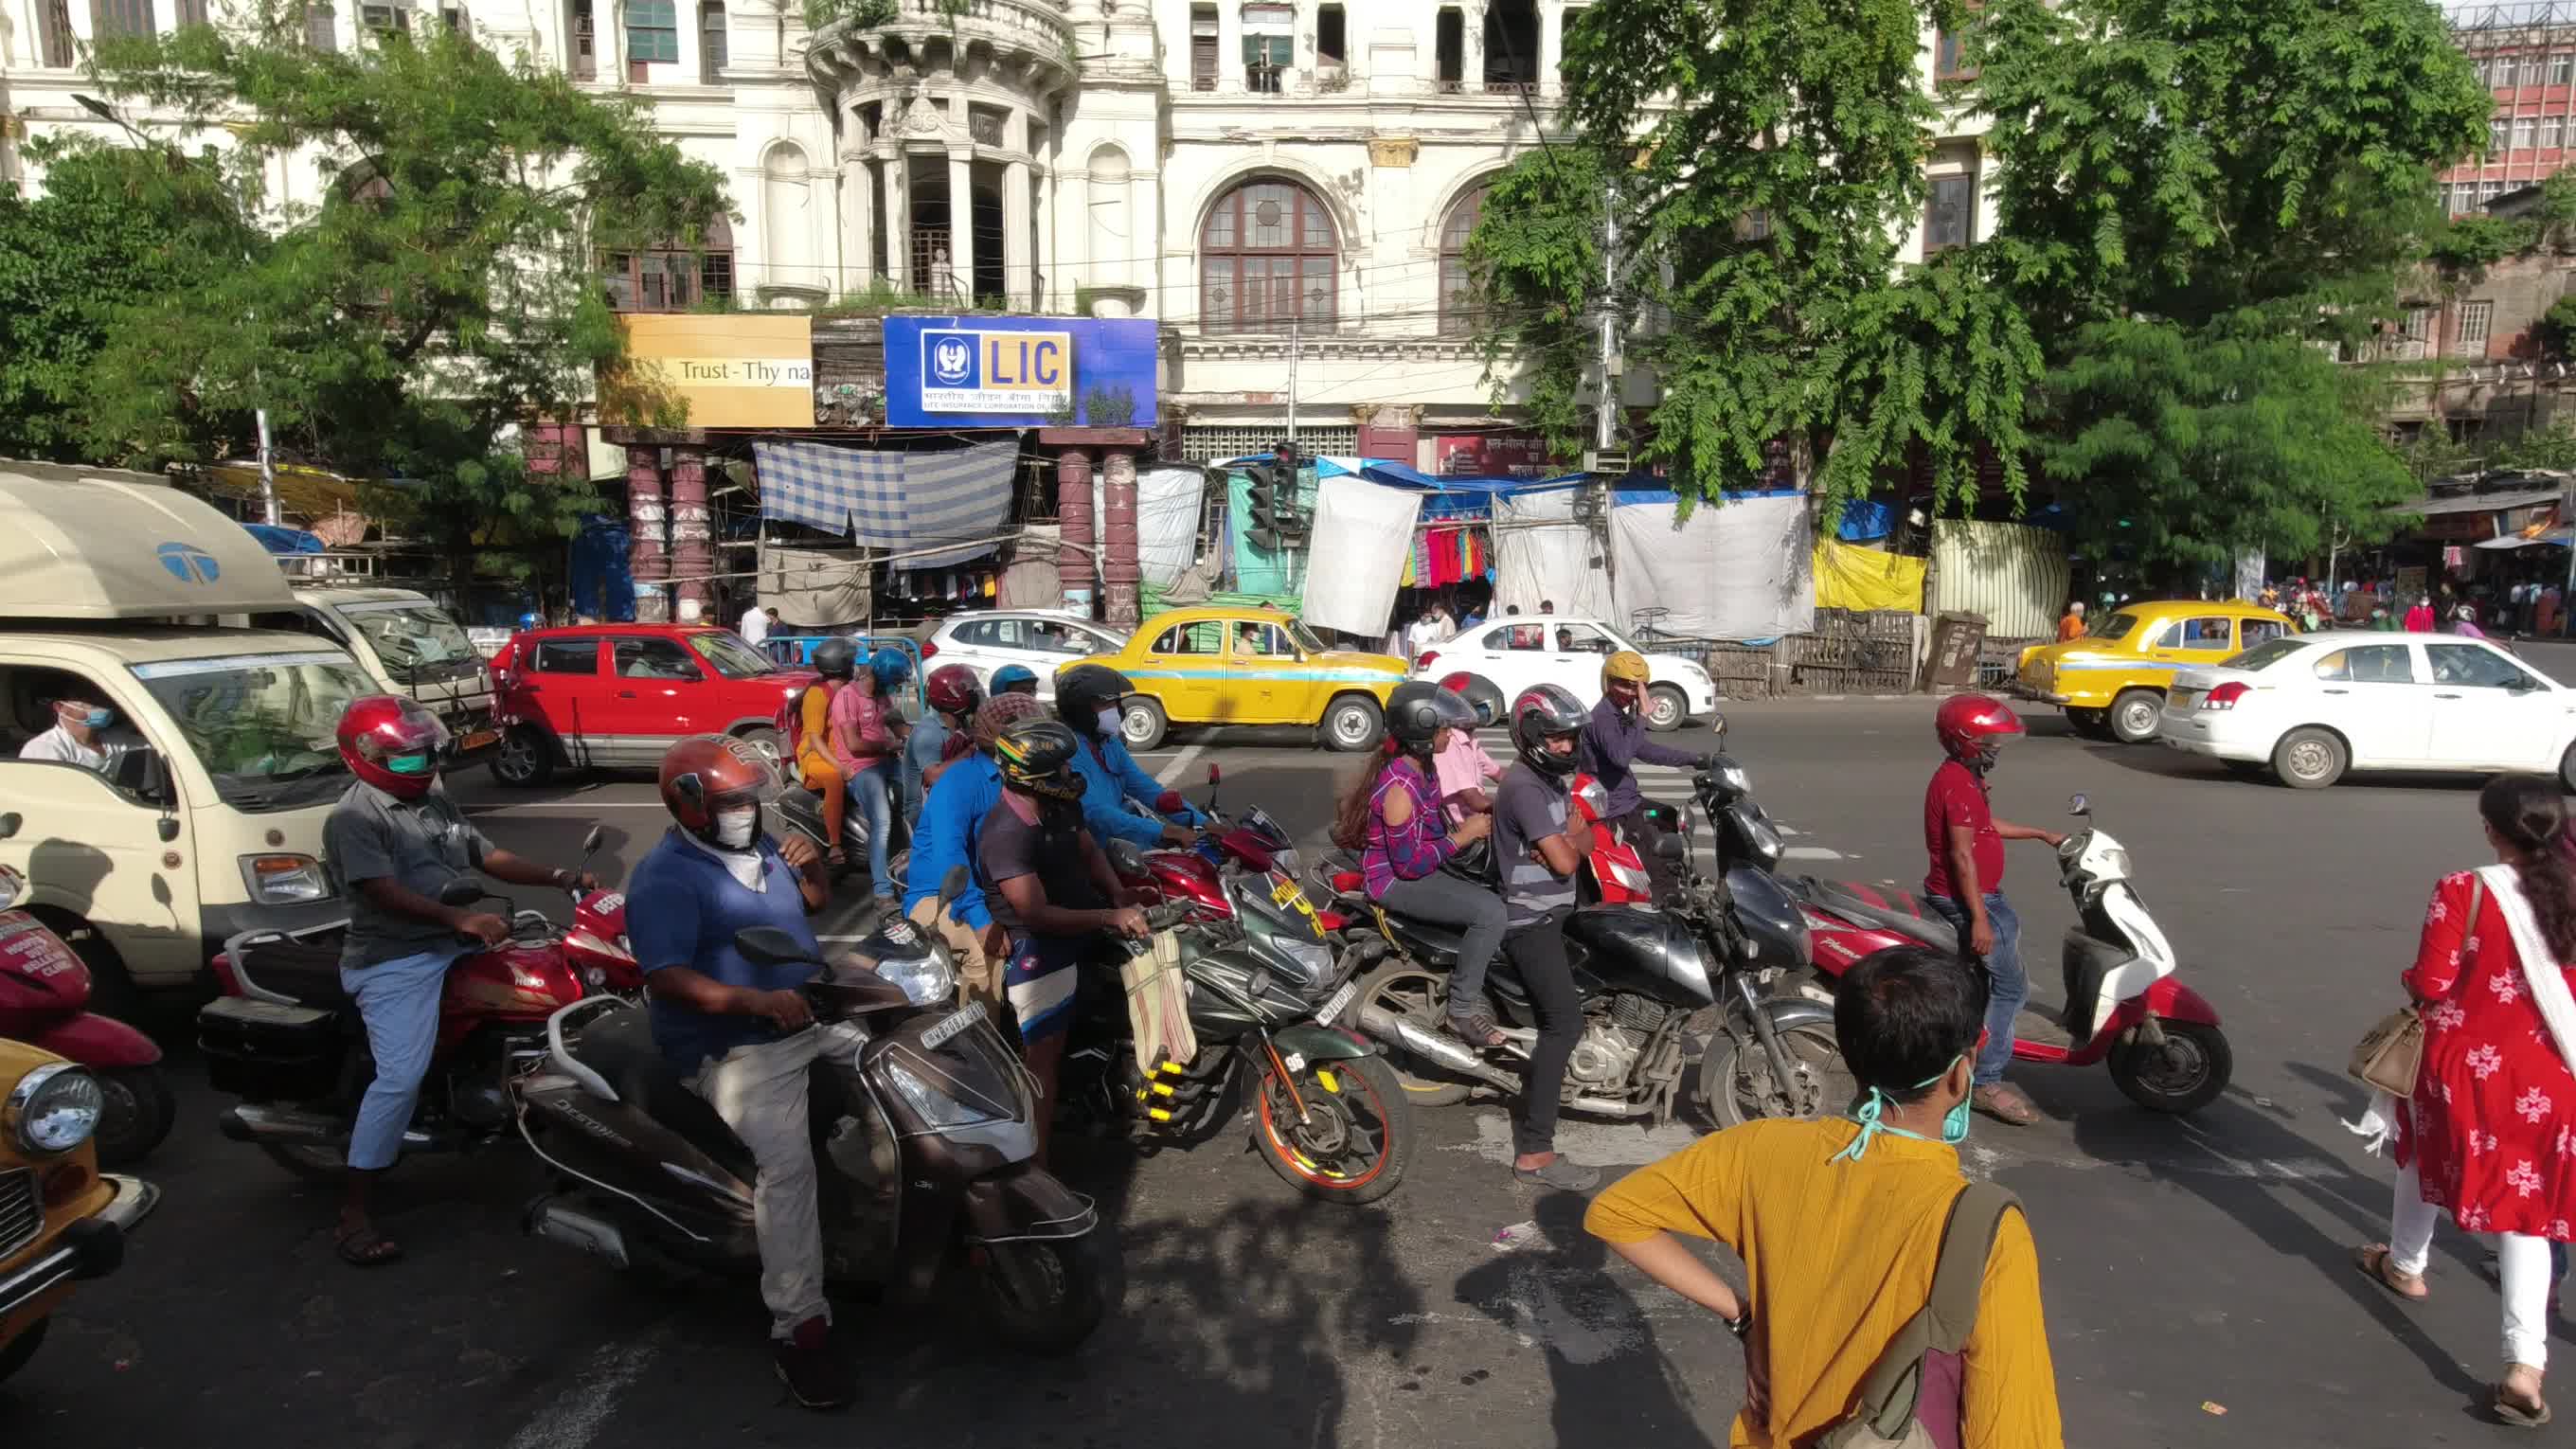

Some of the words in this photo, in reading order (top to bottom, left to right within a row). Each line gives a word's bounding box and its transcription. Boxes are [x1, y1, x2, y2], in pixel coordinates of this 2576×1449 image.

[679, 361, 730, 380] Trust
[742, 361, 780, 387] Thy
[991, 340, 1059, 385] LIC
